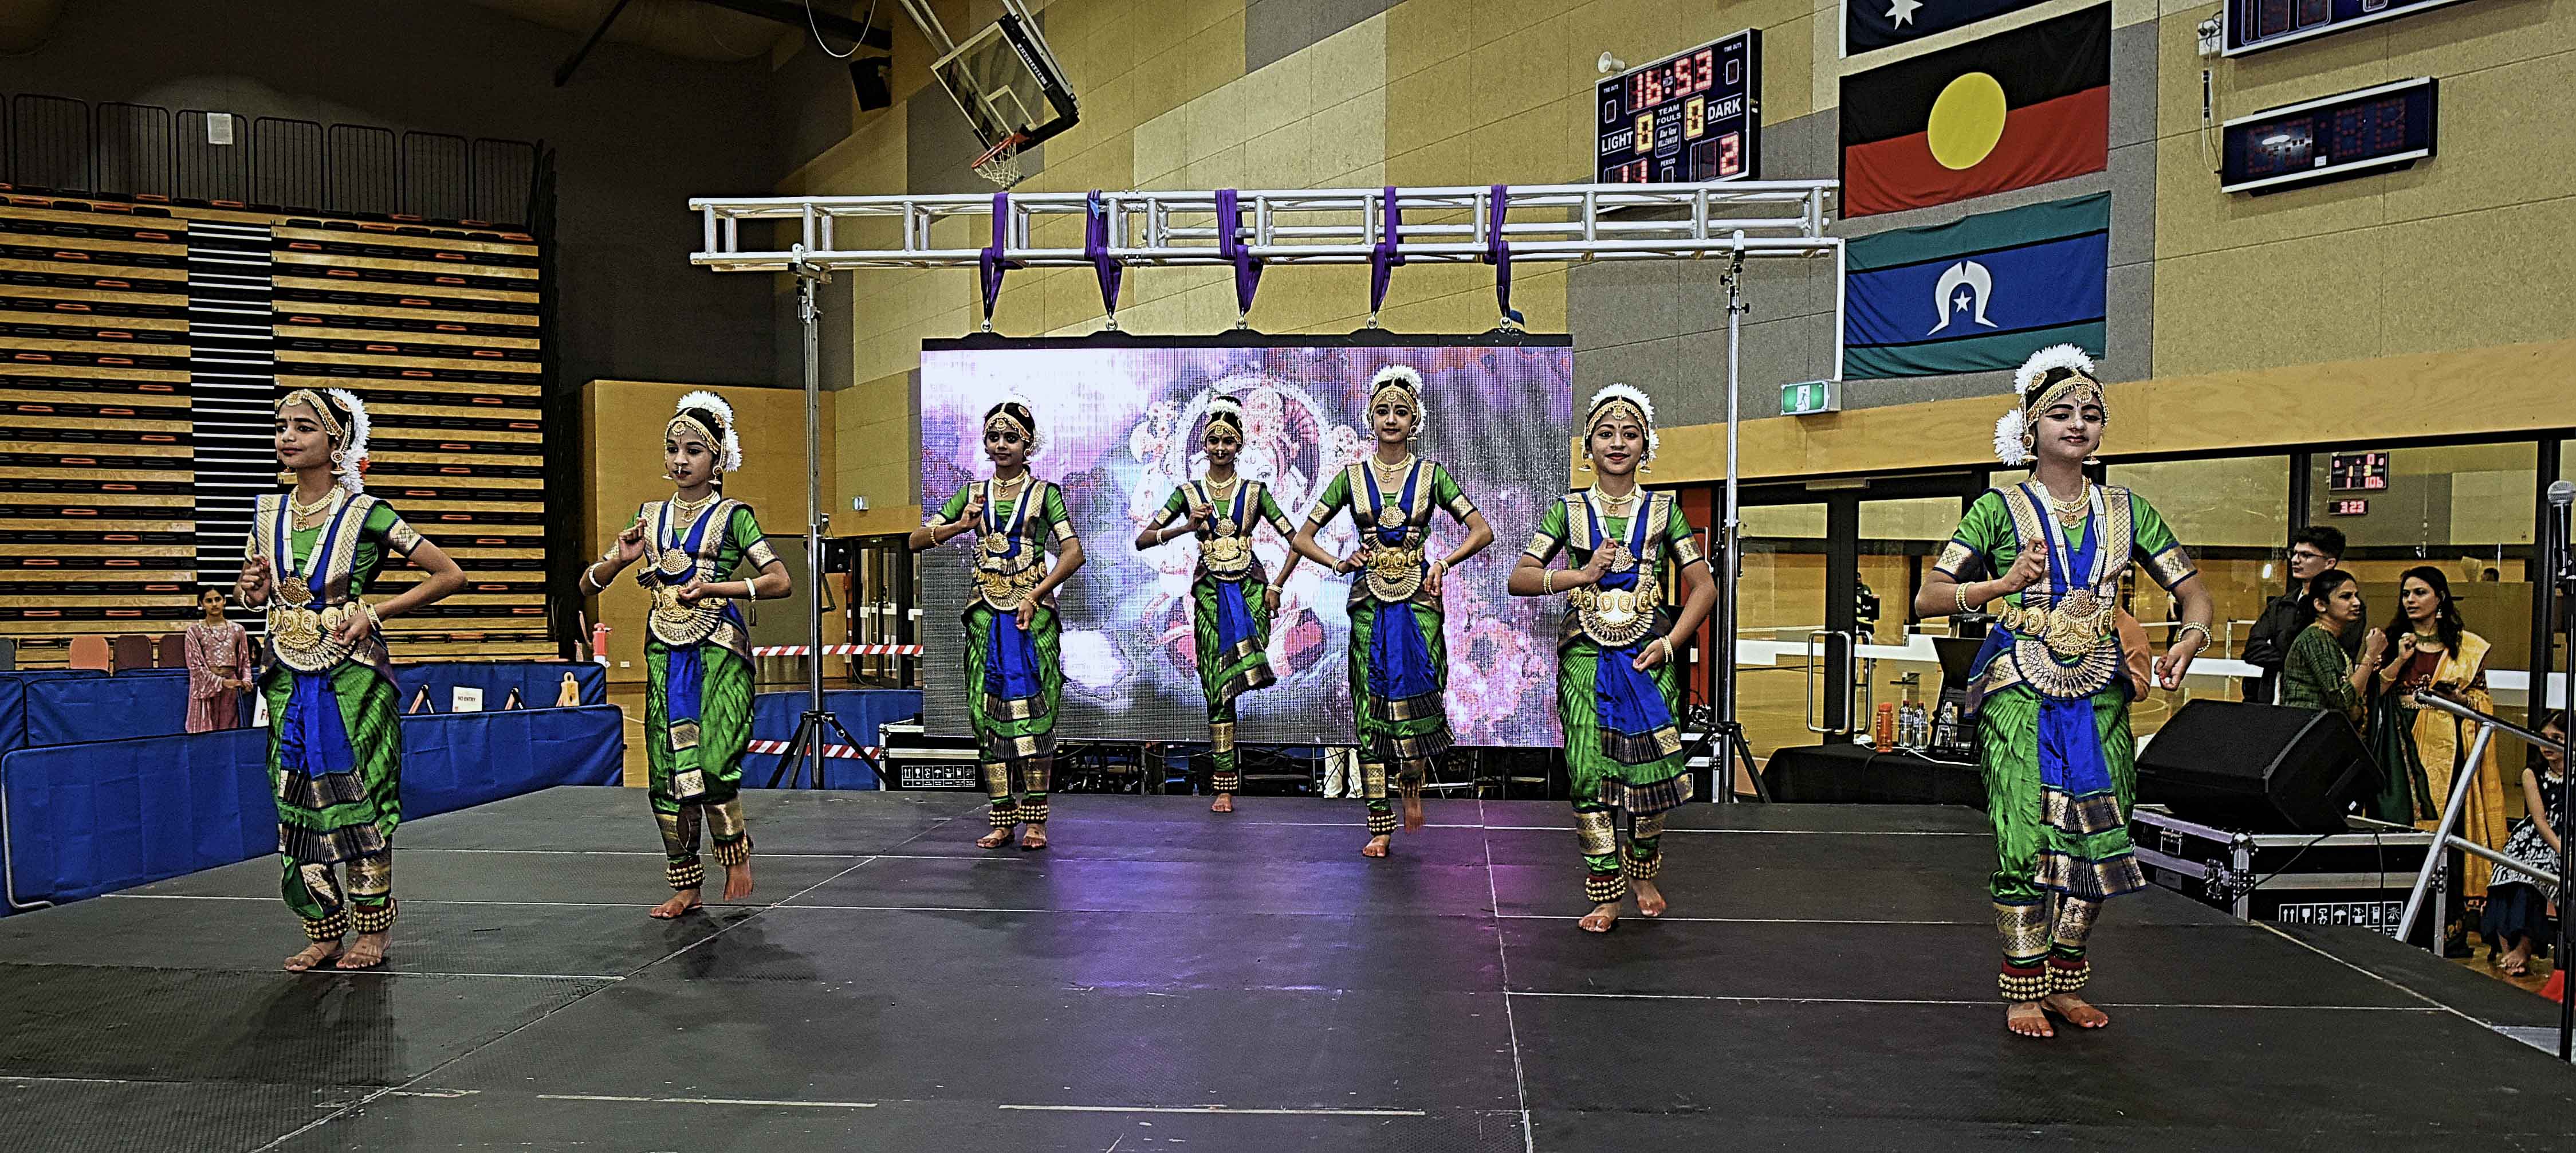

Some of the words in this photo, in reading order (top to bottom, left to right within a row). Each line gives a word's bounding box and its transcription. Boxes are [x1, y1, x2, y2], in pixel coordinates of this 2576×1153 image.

[1658, 104, 1680, 116] TEAM
[1708, 98, 1741, 121] DARK
[1657, 112, 1681, 125] FOULS
[1602, 131, 1633, 152] LIGHT
[1720, 135, 1739, 175] 2
[1660, 157, 1676, 167] PERIOD
[2363, 465, 2372, 477] 3
